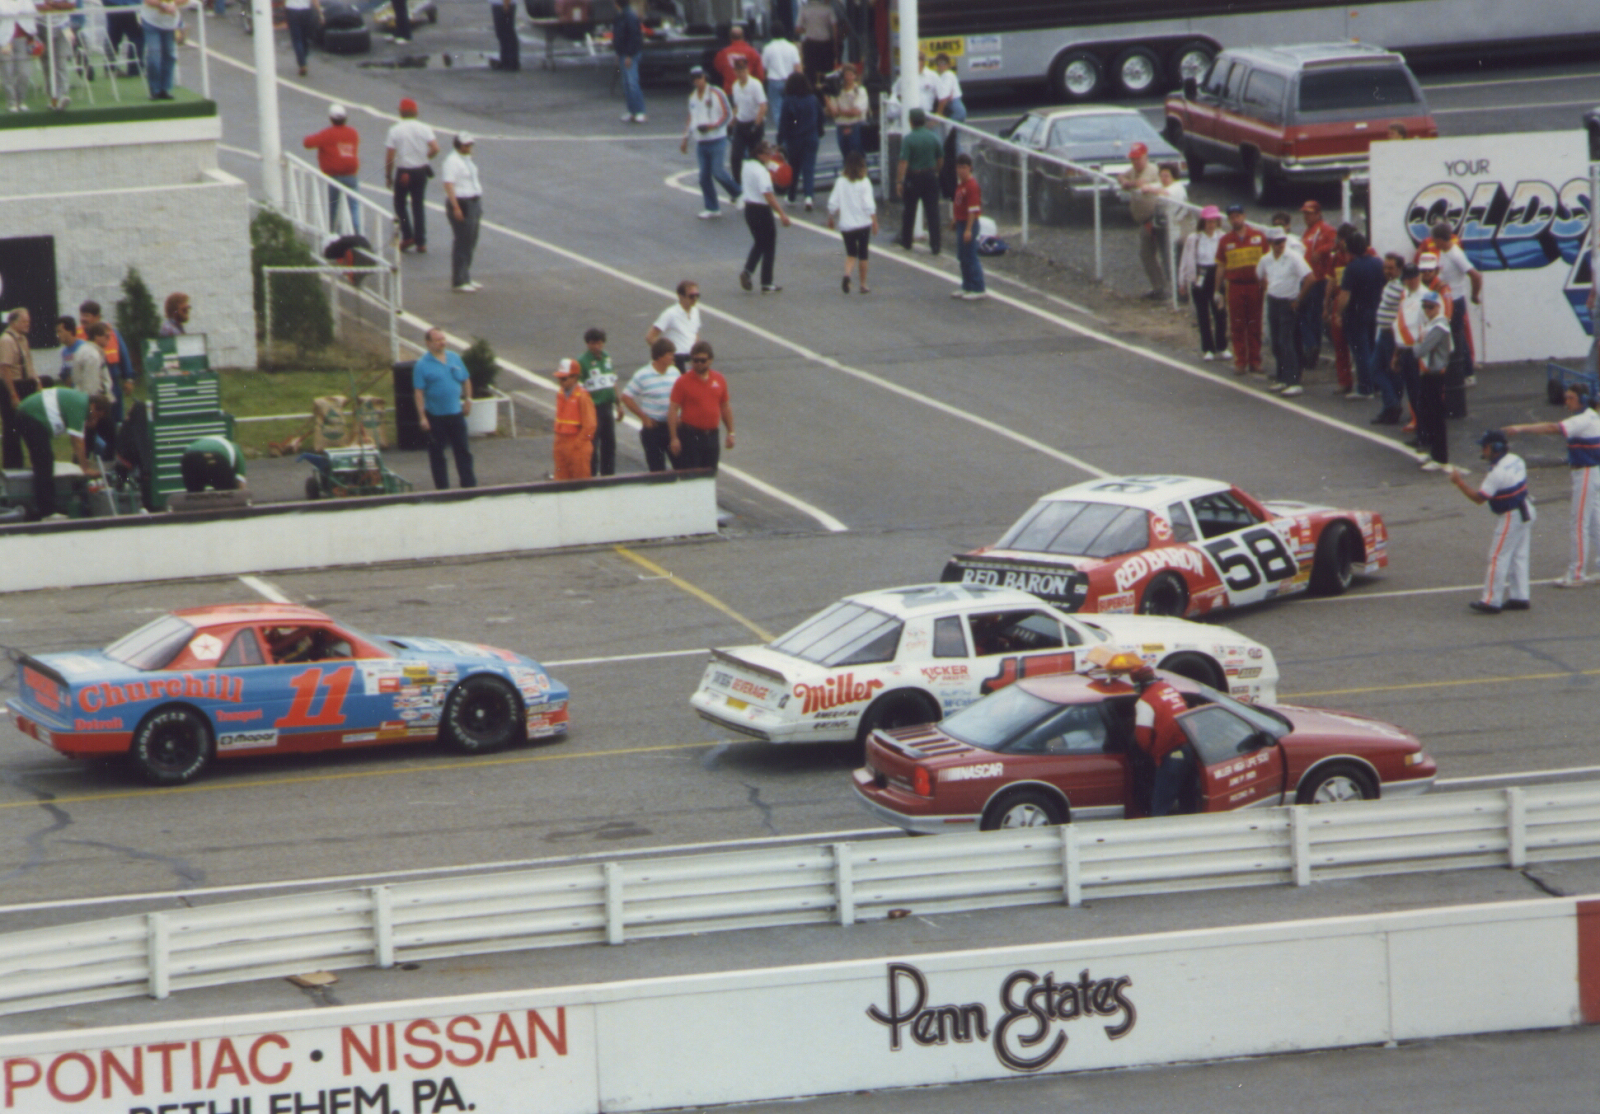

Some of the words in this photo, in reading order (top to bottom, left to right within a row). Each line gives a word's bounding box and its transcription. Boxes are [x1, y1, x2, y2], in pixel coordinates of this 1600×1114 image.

[1444, 159, 1490, 176] YOUR
[1114, 556, 1148, 593] RED
[1140, 547, 1205, 577] BARON
[1203, 528, 1297, 591] 58
[962, 568, 999, 586] RED
[1004, 571, 1070, 595] BARON
[921, 664, 968, 681] KICKER
[78, 673, 245, 713] Churchill
[274, 666, 354, 728] 11
[793, 673, 885, 714] Miller
[233, 732, 276, 743] Mopar
[961, 762, 1003, 780] NASCAR
[865, 962, 991, 1051] Penn
[993, 969, 1137, 1072] Estates
[2, 1033, 293, 1103] PONTIAC
[340, 1006, 568, 1077] NISSAN
[411, 1077, 476, 1114] PA.
